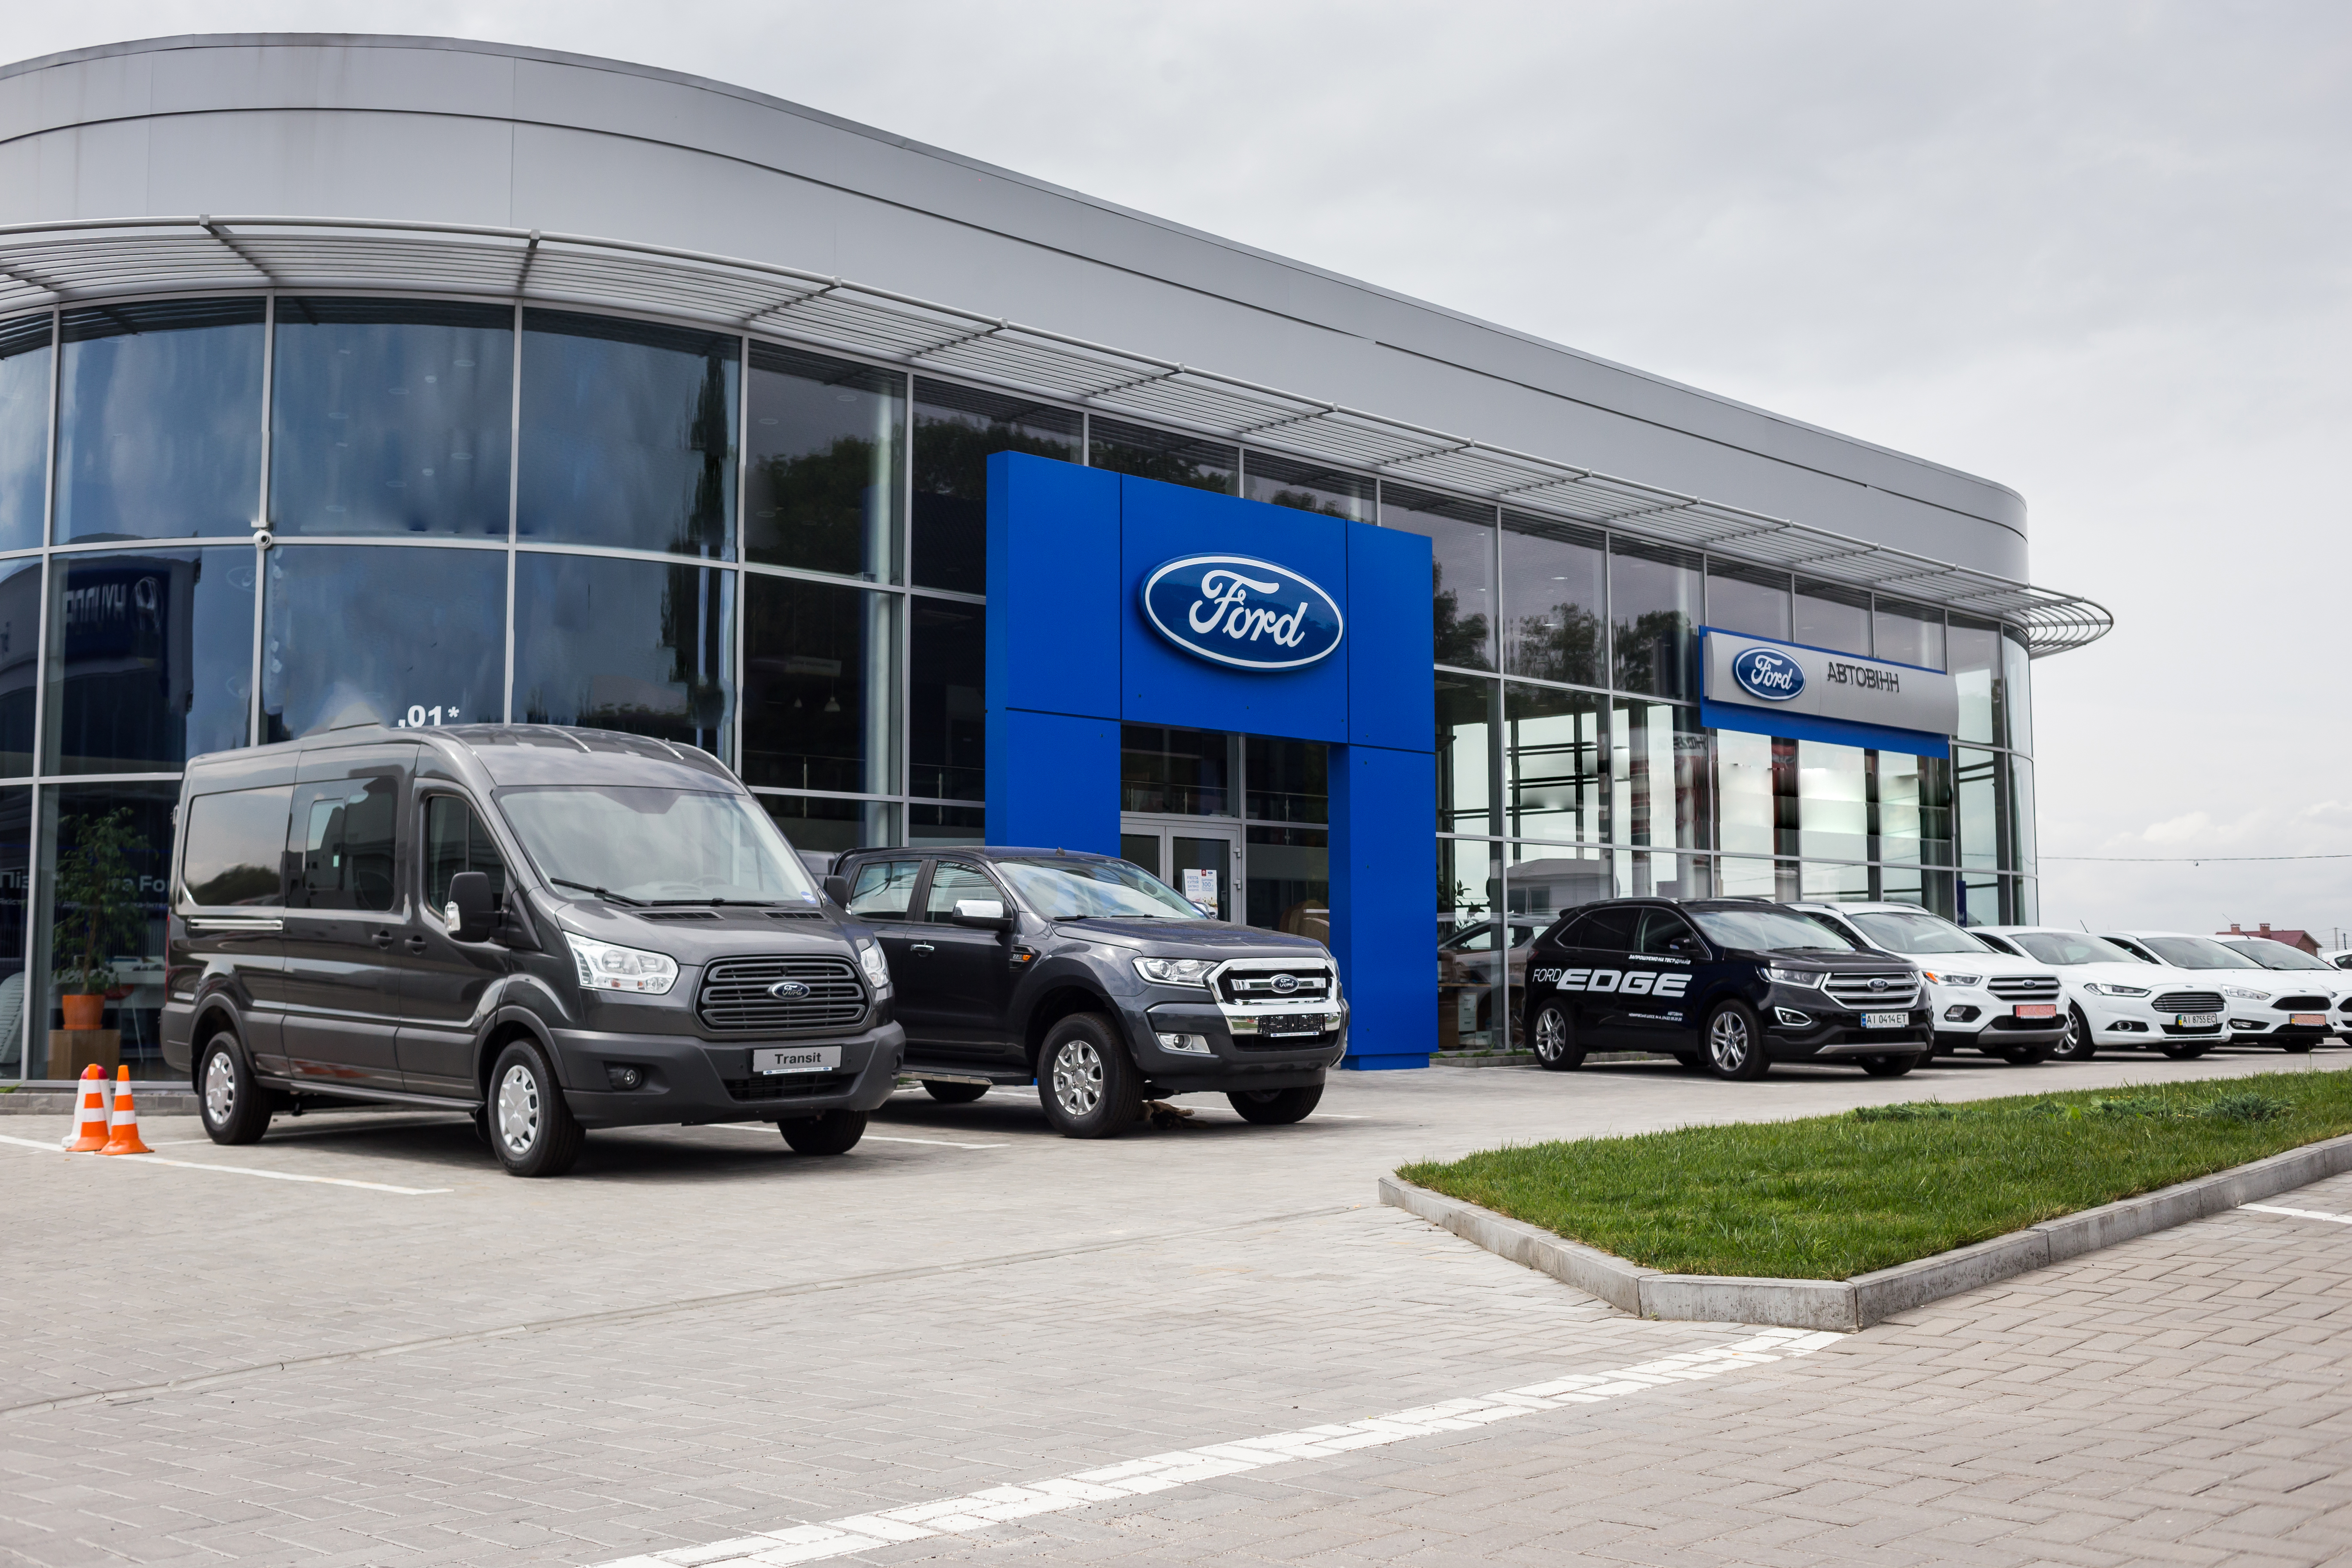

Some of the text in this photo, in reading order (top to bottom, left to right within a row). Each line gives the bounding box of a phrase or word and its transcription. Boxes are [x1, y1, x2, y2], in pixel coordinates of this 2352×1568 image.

[1189, 570, 1308, 647] Ford
[1751, 655, 1793, 690] Ford
[1827, 661, 1900, 693] АВТОВІНН
[782, 984, 803, 996] Ford
[1280, 978, 1294, 987] Ford
[1532, 968, 1692, 997] FORD EDGE
[1867, 1014, 1906, 1024] AI 0414 ET
[775, 1053, 821, 1064] Transit
